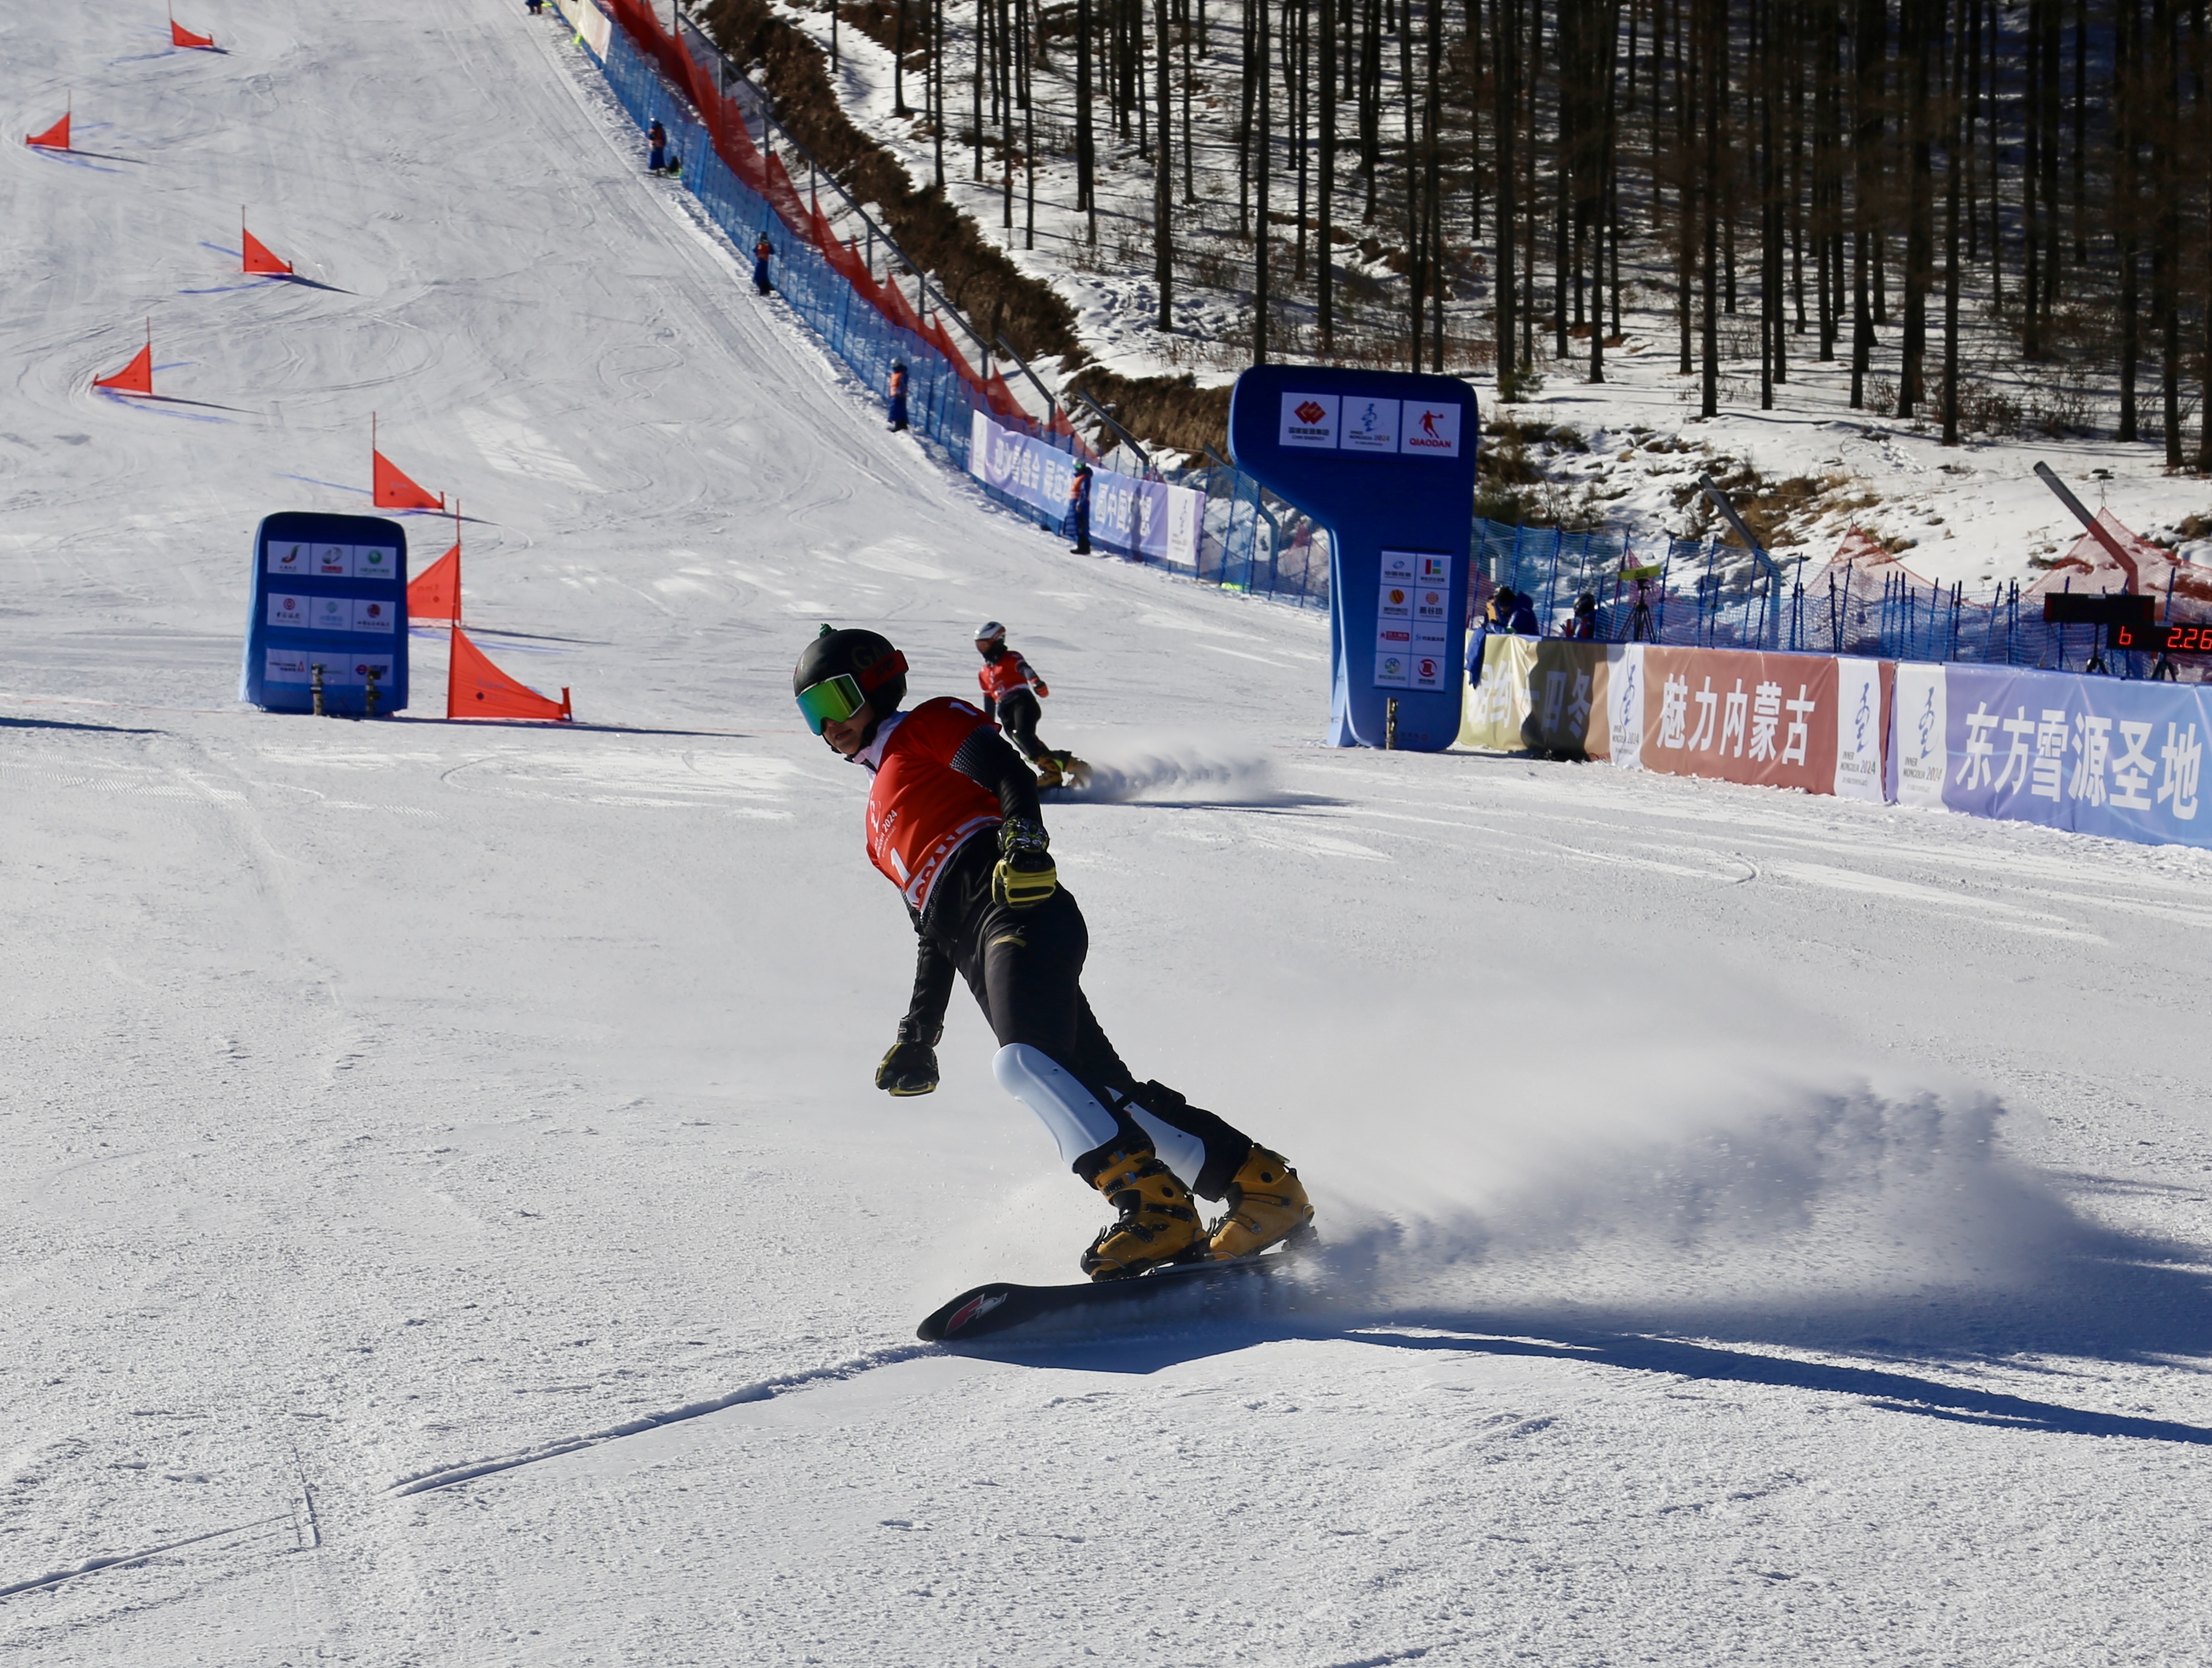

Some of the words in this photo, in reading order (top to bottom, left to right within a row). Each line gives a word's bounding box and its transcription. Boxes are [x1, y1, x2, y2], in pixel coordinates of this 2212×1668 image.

[1409, 437, 1451, 449] QIAODAN
[1656, 673, 1814, 766] 魅力内蒙古
[1627, 732, 1639, 745] 2024
[1842, 751, 1854, 760] INNER
[1905, 756, 1918, 766] INNER
[1956, 701, 2202, 821] 东方雪源圣地
[1841, 762, 1859, 772] MONGOLIA
[1860, 759, 1876, 775] 2024
[1903, 768, 1925, 779] MONGOLIA
[1926, 766, 1942, 781] 2024
[882, 809, 898, 833] 2024
[890, 847, 911, 883] 1
